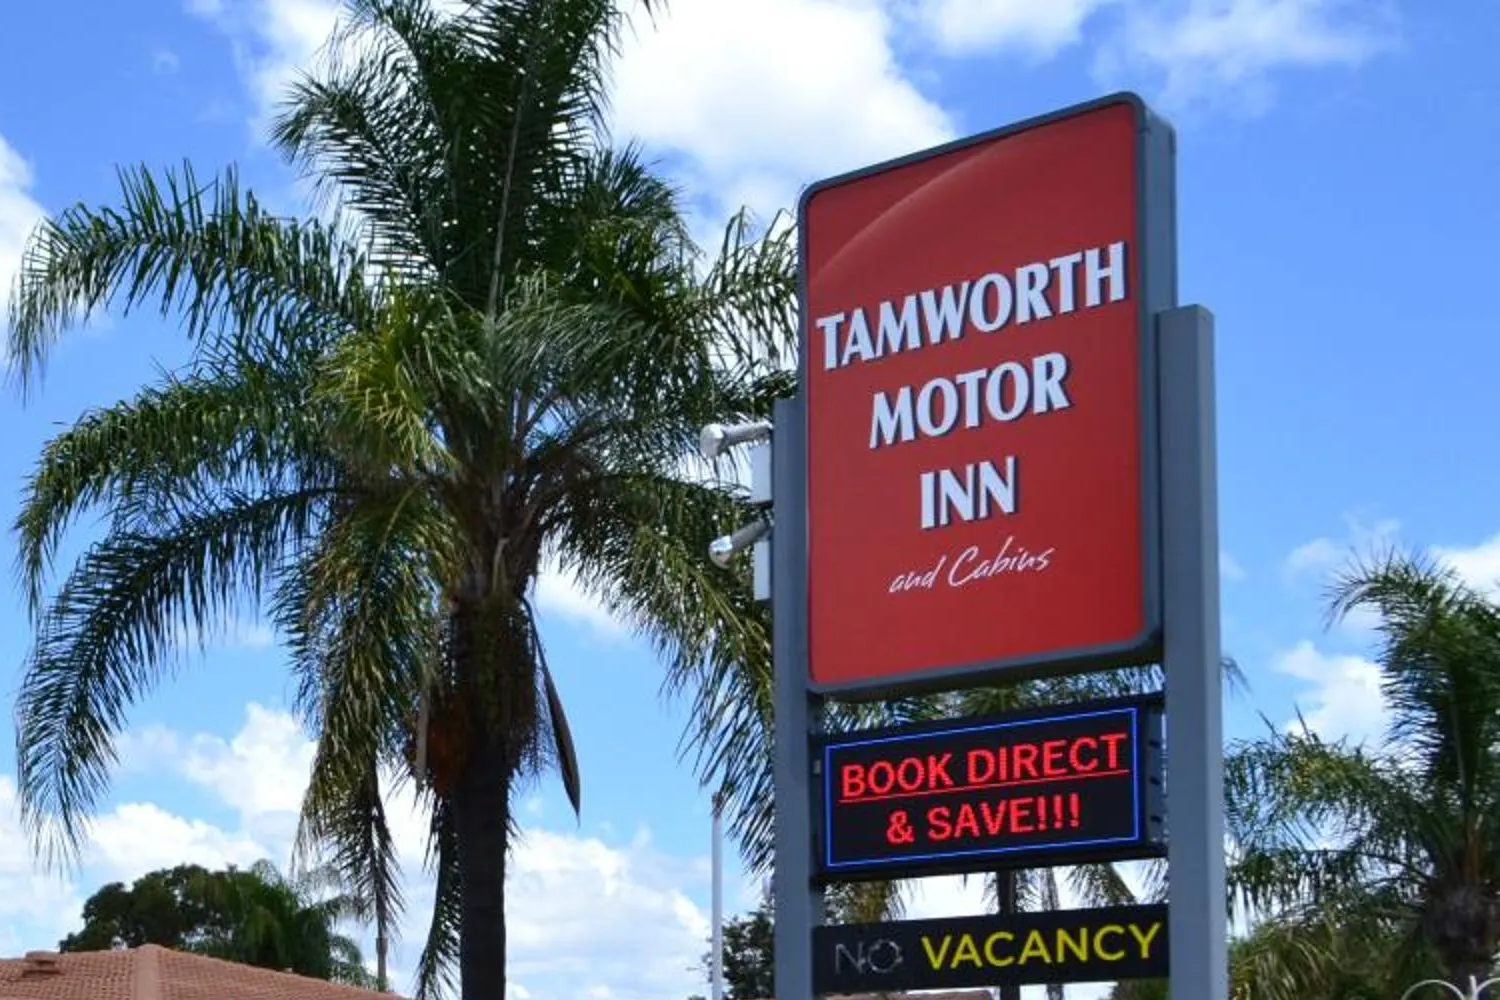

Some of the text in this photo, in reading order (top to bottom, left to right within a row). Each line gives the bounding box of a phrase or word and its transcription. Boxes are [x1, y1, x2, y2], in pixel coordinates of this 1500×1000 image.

[816, 241, 1126, 371] TAMWORTH
[869, 352, 1071, 449] MOTOR
[920, 455, 1017, 530] INN
[888, 536, 1056, 593] and Cabins
[841, 732, 1128, 798] BOOK DIRECT
[885, 792, 1081, 844] & SAVE!!!
[834, 922, 1162, 975] NO VACANCY
